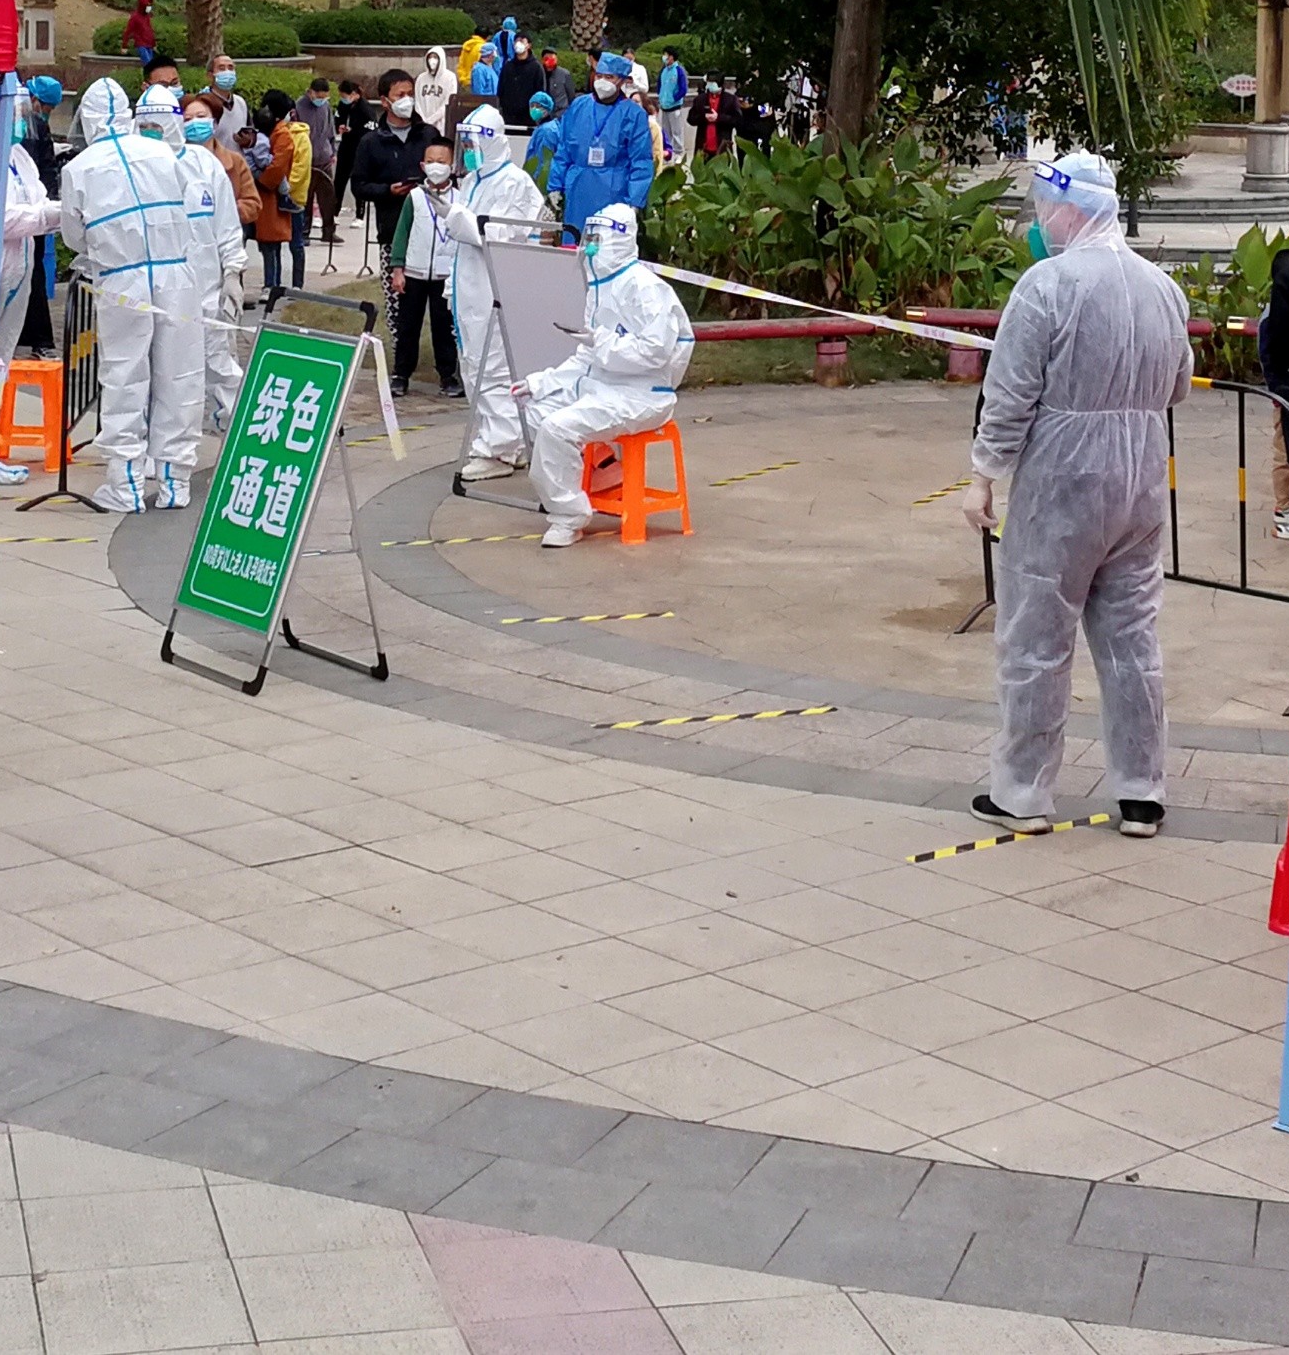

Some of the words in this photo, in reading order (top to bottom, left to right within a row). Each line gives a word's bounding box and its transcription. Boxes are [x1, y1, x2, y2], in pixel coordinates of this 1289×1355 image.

[422, 84, 444, 97] GAP
[247, 372, 323, 453] 绿色
[221, 456, 301, 538] 通道
